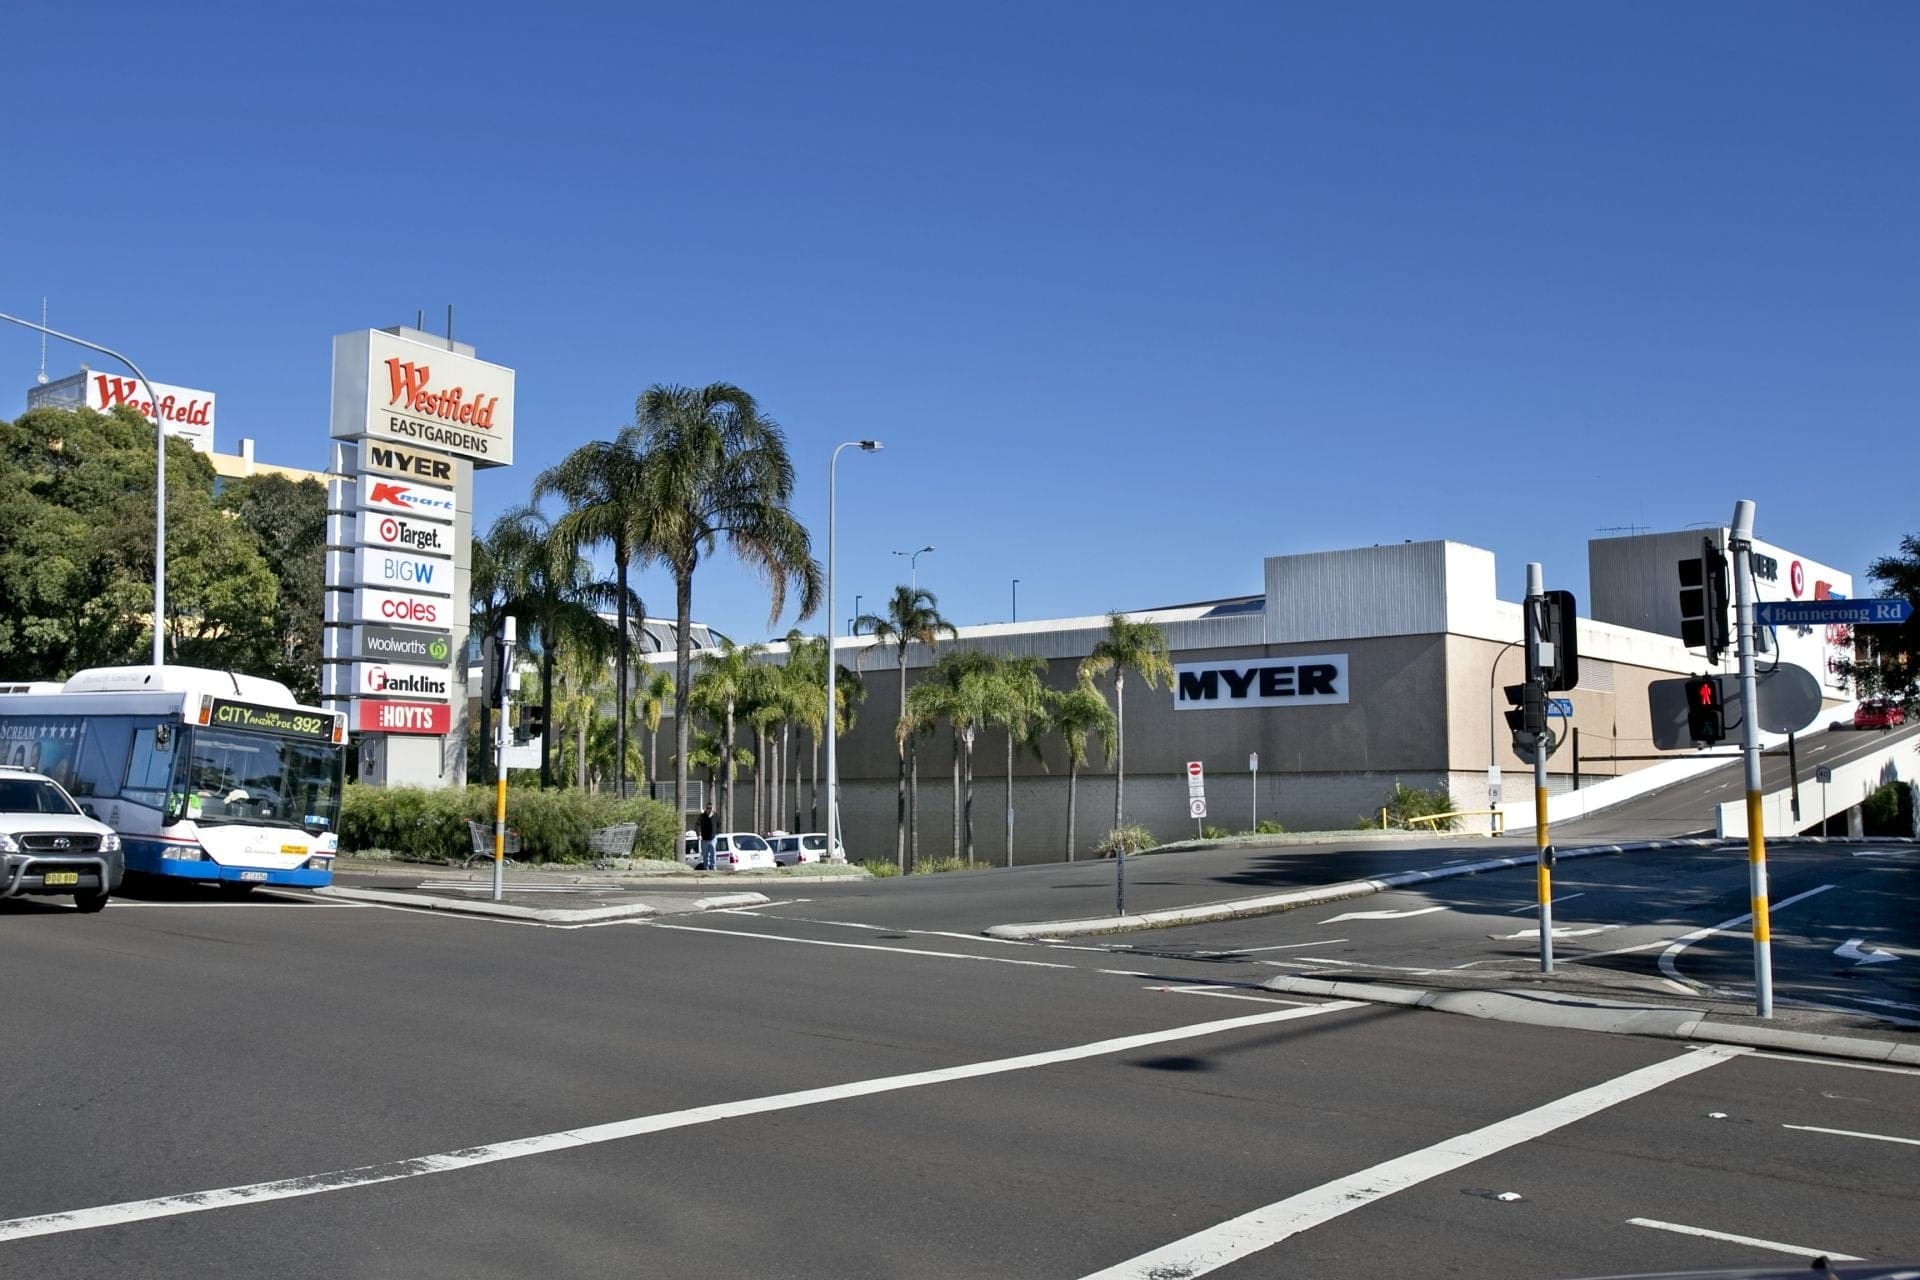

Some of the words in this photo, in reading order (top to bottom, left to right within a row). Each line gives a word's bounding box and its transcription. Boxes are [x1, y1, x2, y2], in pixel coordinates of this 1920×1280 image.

[385, 358, 498, 430] Westfield
[390, 417, 488, 454] EASTGARDENS
[372, 447, 451, 480] MYER
[370, 482, 453, 509] Kmart
[381, 598, 436, 622] coles
[1775, 606, 1870, 623] Bunnerong
[1876, 603, 1902, 619] Rd
[367, 637, 426, 655] Woolworths
[368, 666, 446, 693] Franklins
[1179, 664, 1338, 700] MYER
[219, 706, 252, 724] CITY
[293, 716, 321, 733] 392
[383, 705, 433, 729] HOYTS
